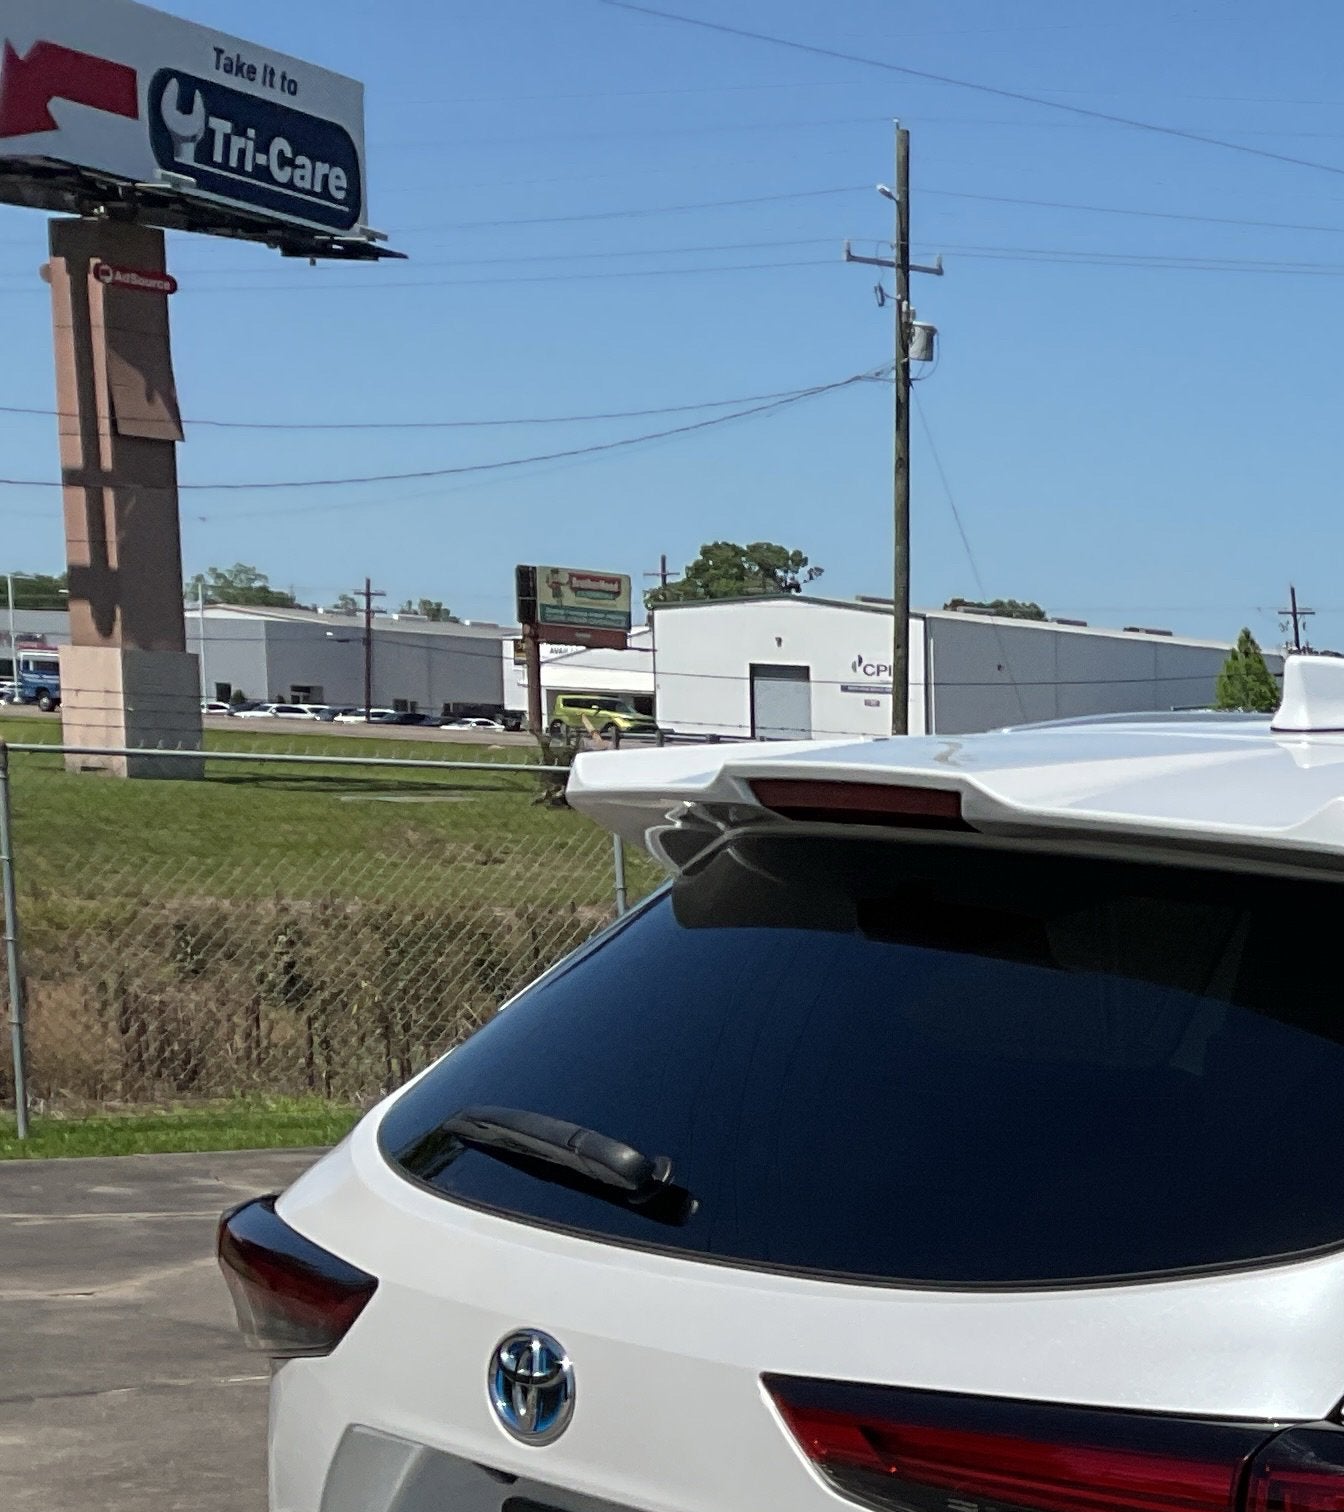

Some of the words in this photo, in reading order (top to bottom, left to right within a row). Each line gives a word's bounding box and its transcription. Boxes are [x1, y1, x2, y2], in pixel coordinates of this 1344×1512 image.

[213, 46, 257, 82] Take
[280, 70, 298, 96] to
[208, 115, 348, 200] Tri-Care
